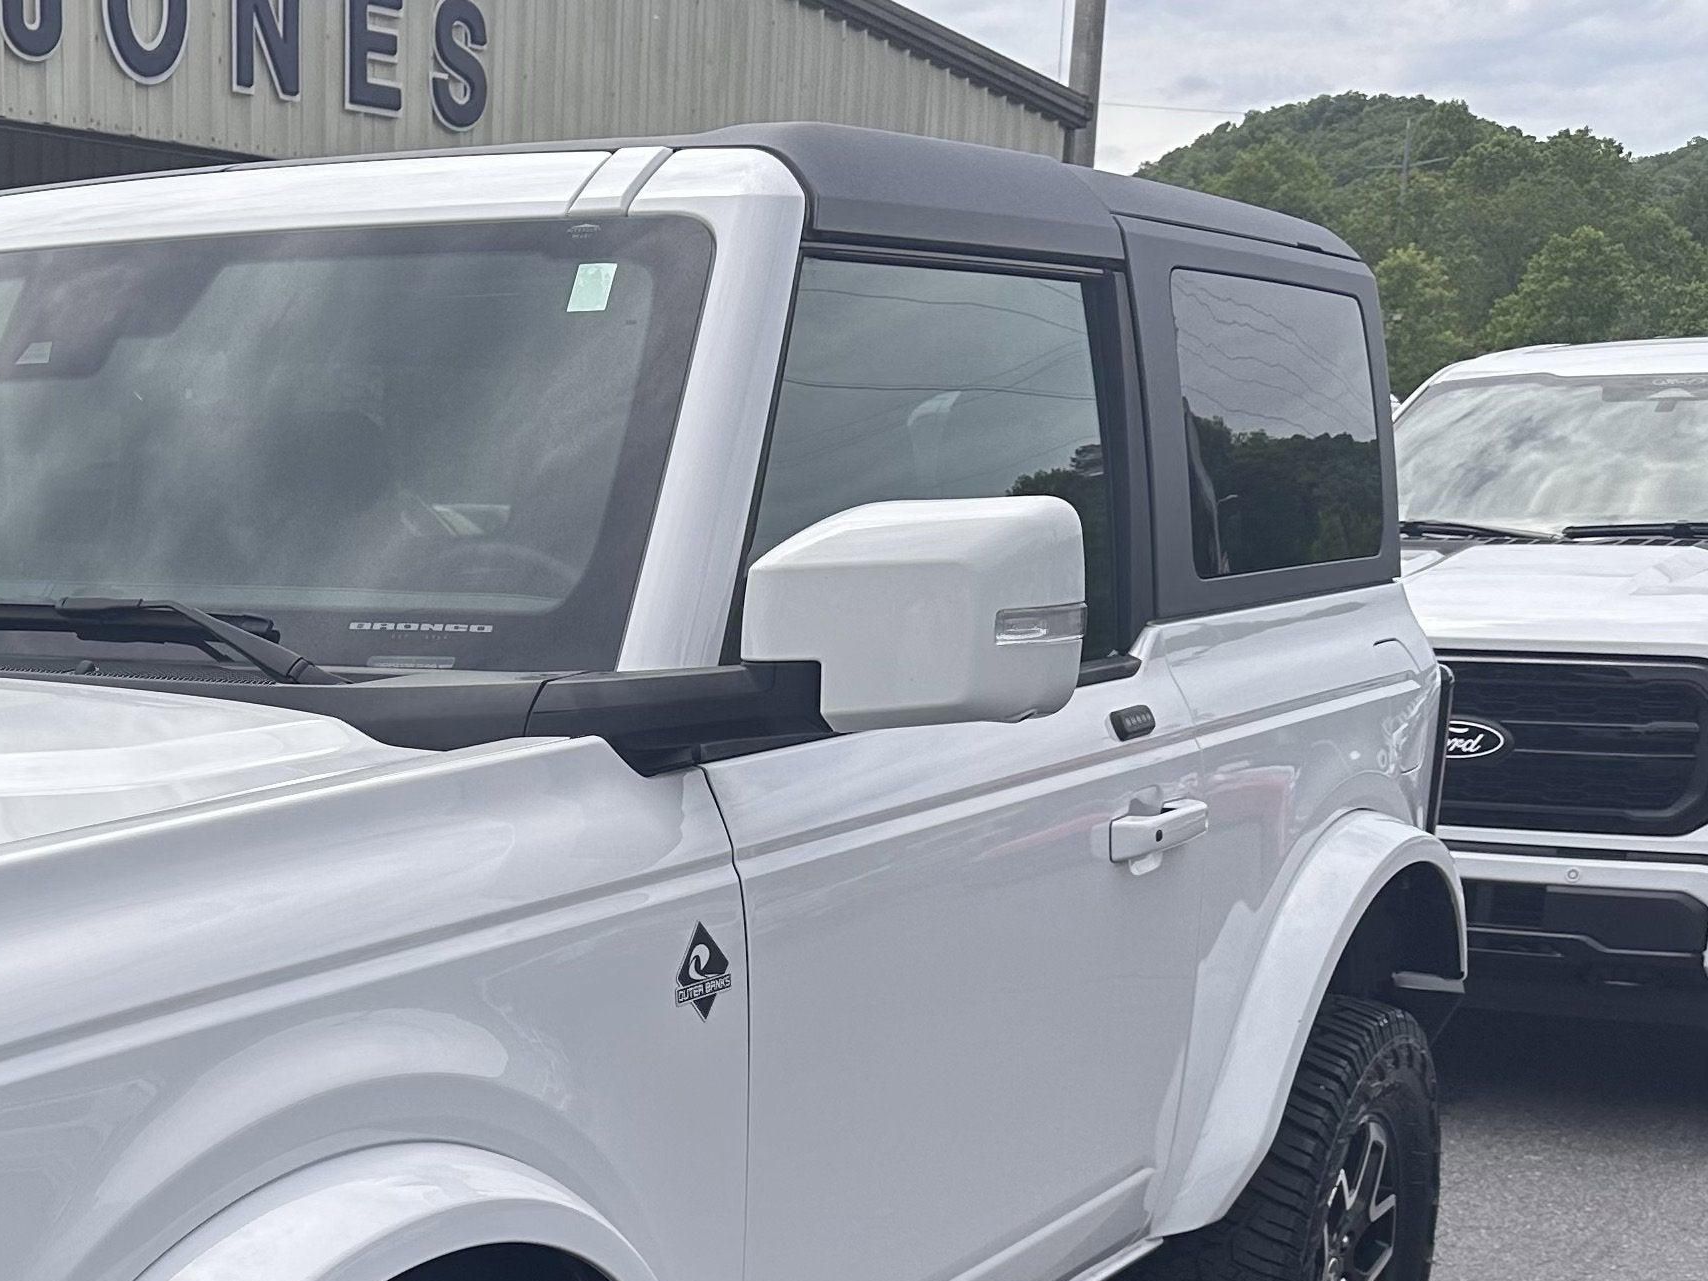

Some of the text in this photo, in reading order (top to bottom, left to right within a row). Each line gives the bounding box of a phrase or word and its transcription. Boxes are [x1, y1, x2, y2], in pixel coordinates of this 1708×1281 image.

[348, 622, 493, 633] BRONCO
[678, 976, 731, 1002] OUTER BANKS
